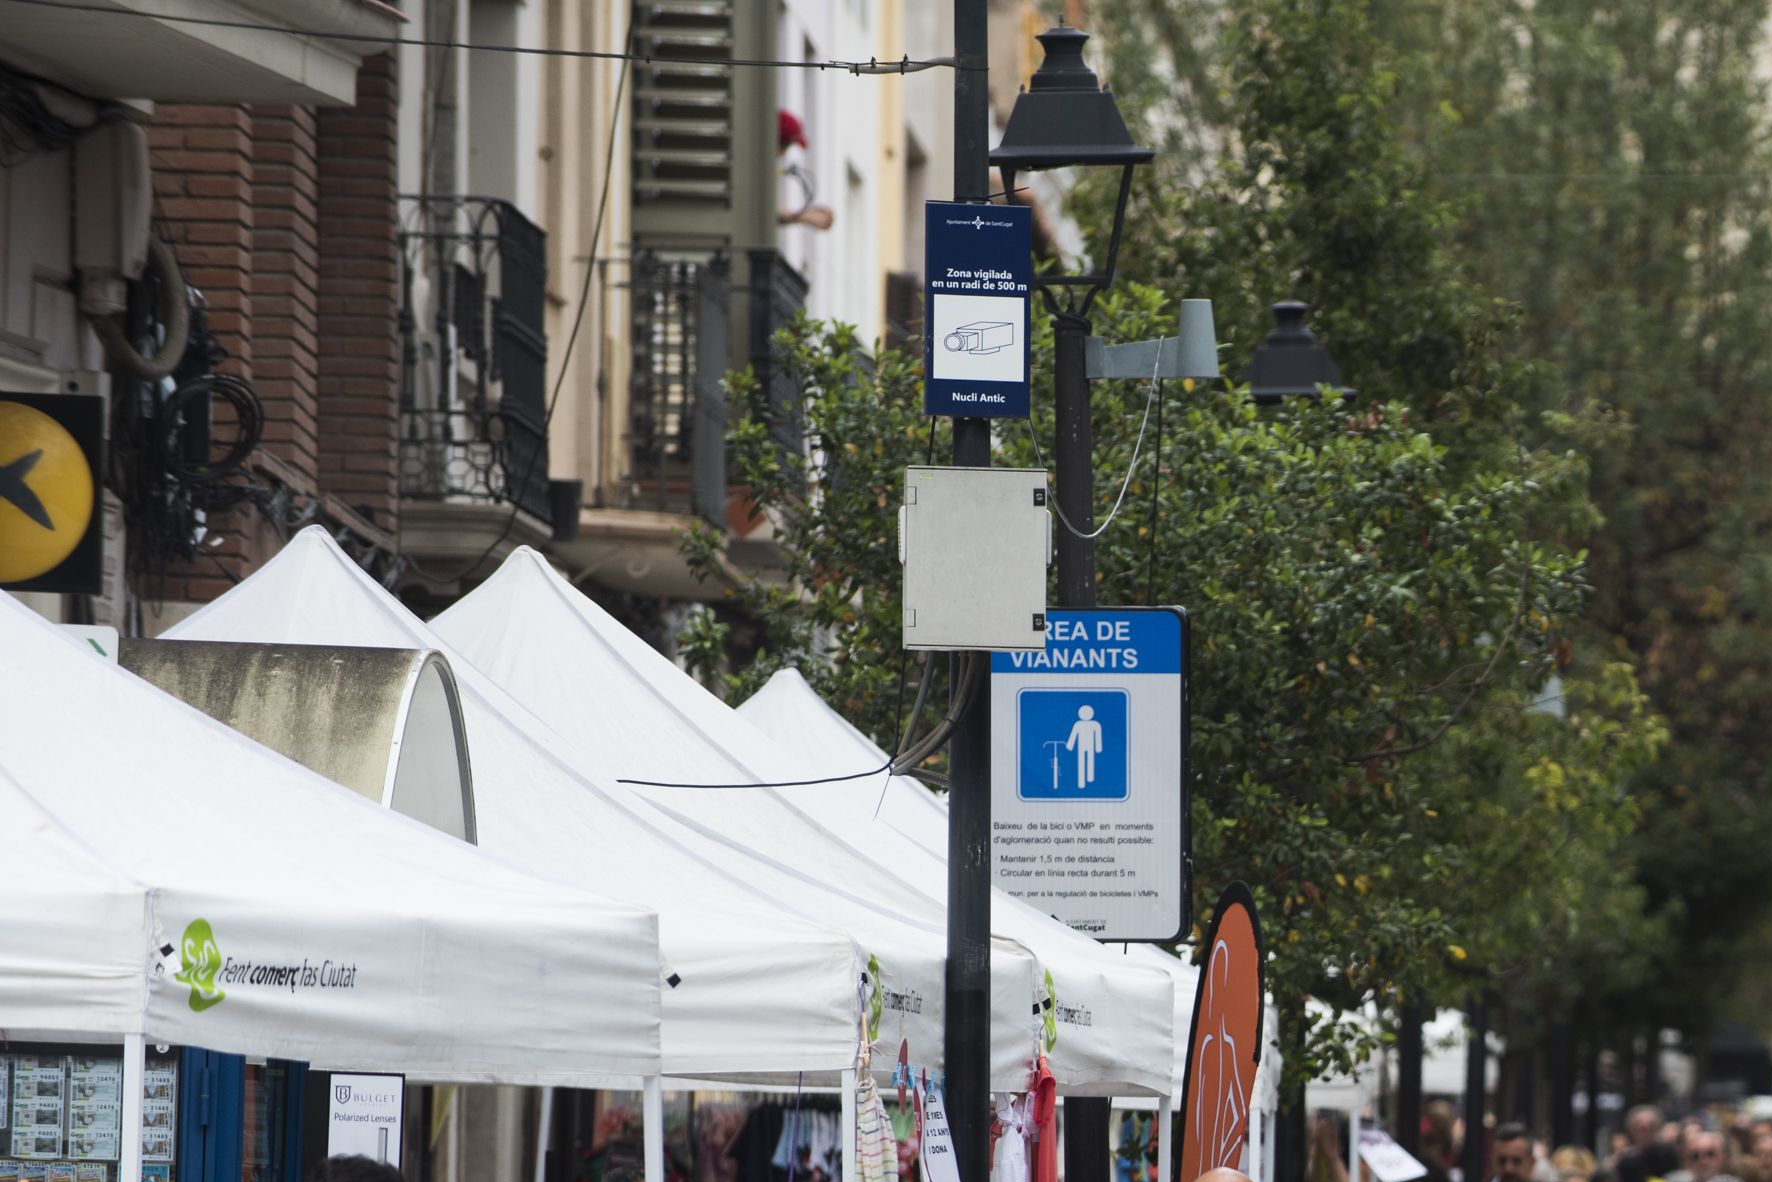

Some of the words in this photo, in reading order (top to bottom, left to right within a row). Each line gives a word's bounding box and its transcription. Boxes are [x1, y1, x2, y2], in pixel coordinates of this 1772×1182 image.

[947, 268, 972, 278] Zona
[974, 269, 1012, 280] vigilada
[962, 280, 980, 289] radi
[983, 281, 995, 290] de
[998, 282, 1015, 290] 500
[952, 392, 978, 402] Nucli
[980, 394, 1005, 403] Antic
[1045, 621, 1088, 640] REA
[1096, 621, 1130, 641] DE
[1010, 648, 1138, 668] VIANANTS
[994, 822, 1022, 830] Baixeu
[1027, 822, 1038, 830] de
[1040, 822, 1048, 830] la
[1050, 822, 1064, 830] bici
[1075, 822, 1095, 830] VMP
[994, 836, 1051, 845] d'aglomeració
[1090, 836, 1115, 844] resulti
[1118, 836, 1154, 845] possible:
[1000, 855, 1036, 863] Mantenir
[1040, 855, 1052, 864] 1,5
[1065, 855, 1075, 863] de
[1078, 855, 1115, 863] distància
[1000, 869, 1032, 877] Circular
[1048, 869, 1065, 877] línia
[1090, 869, 1117, 877] durant
[1067, 924, 1105, 932] antCugat
[219, 957, 251, 985] Fent
[250, 965, 300, 993] comerç
[300, 958, 319, 987] fas
[320, 960, 357, 988] Ciutat
[354, 1093, 396, 1103] BULGET
[334, 1113, 369, 1122] Polarized
[371, 1114, 396, 1123] Lenses
[932, 1144, 948, 1154] DONA
